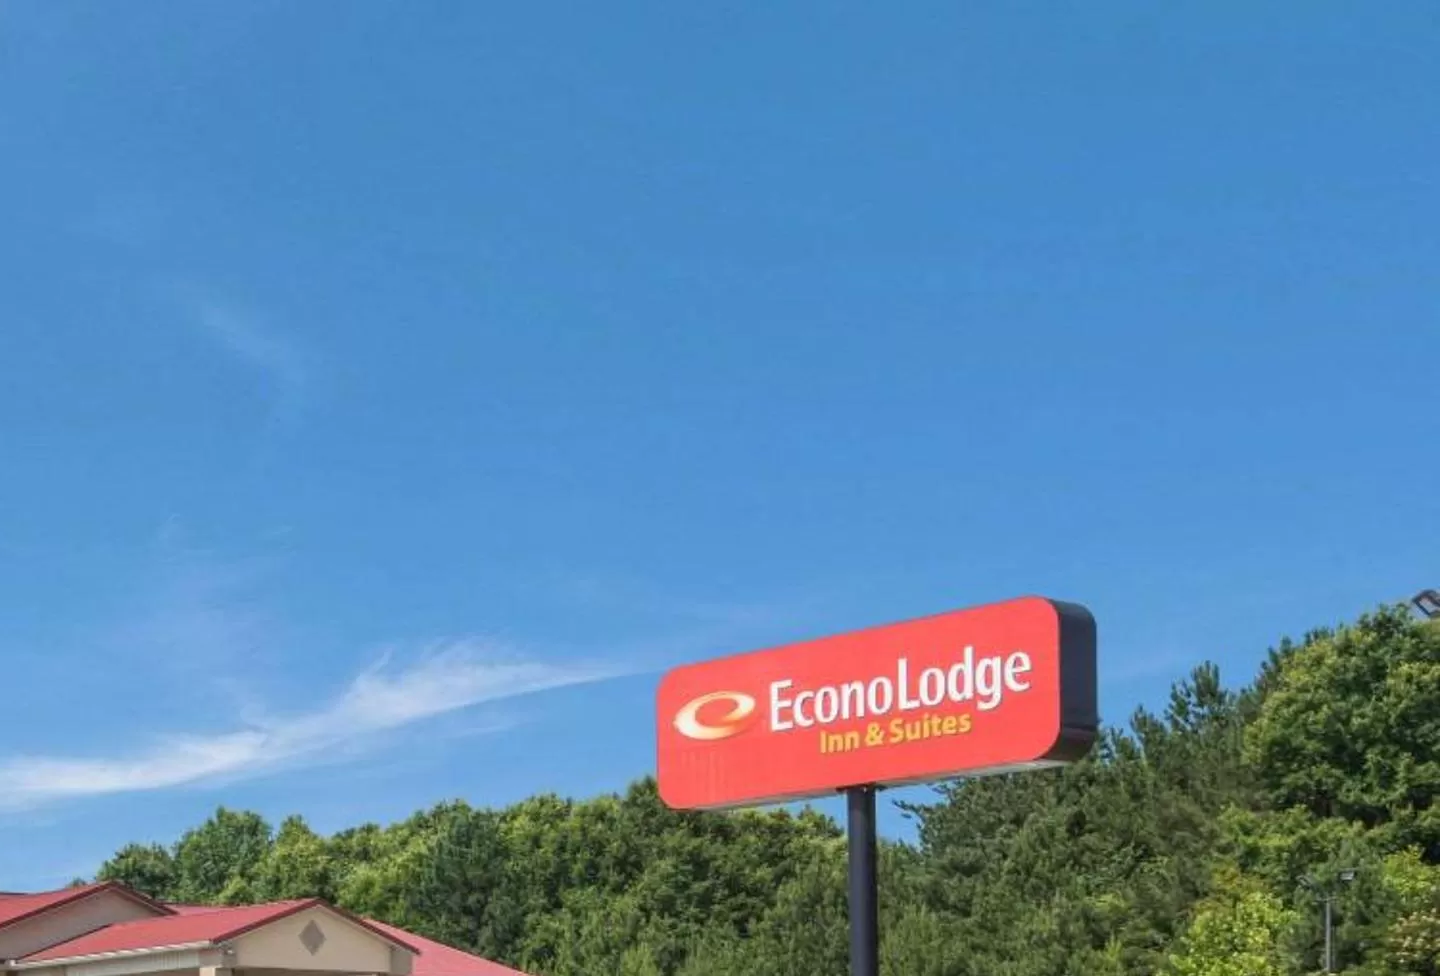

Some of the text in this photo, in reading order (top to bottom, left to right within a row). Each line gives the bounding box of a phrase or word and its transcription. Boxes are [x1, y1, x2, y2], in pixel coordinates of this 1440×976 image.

[819, 711, 972, 754] Inn & Suites
